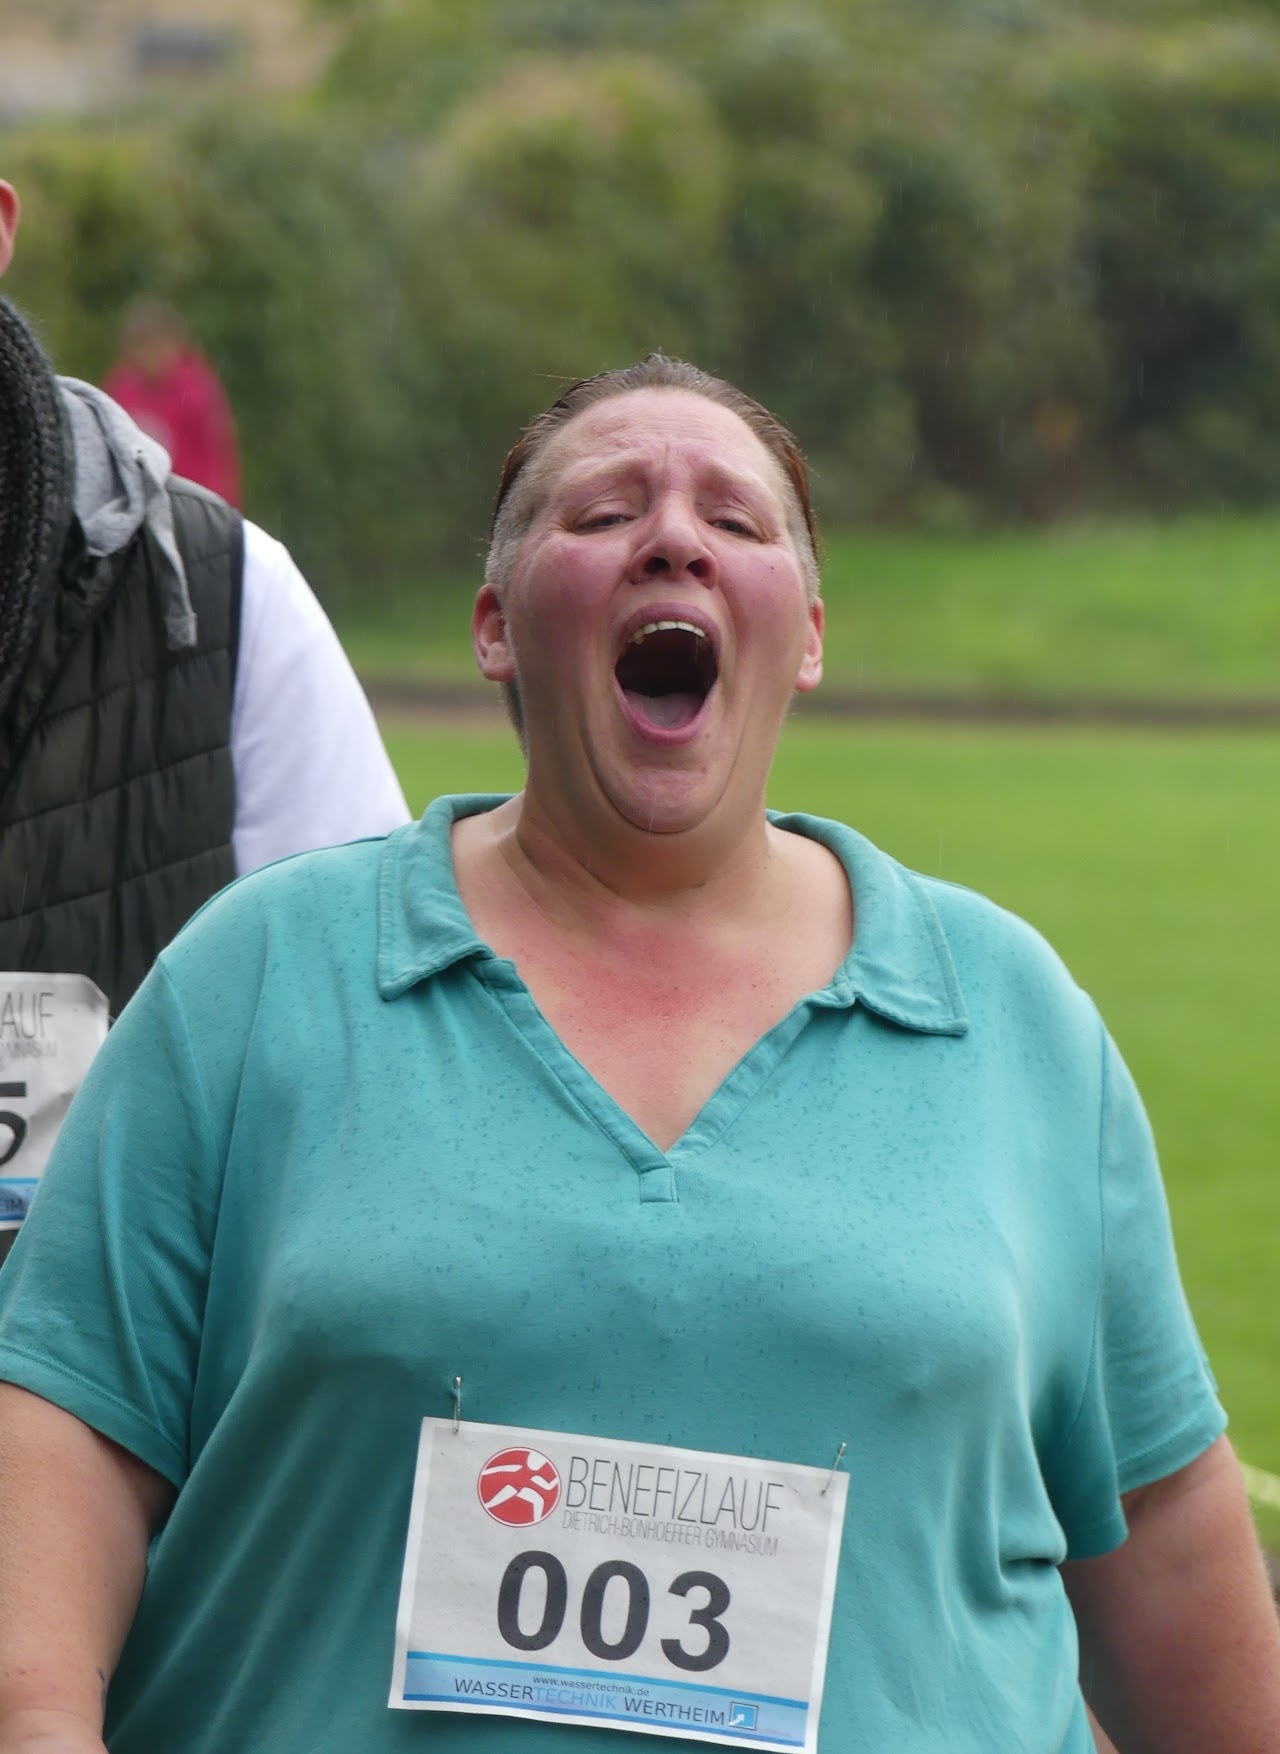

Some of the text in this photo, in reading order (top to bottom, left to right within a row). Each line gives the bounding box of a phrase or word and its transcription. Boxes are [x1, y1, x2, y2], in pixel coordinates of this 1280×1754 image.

[566, 1456, 784, 1533] BENEFIZLAUF
[562, 1510, 779, 1557] DIETRICH-BONHOEFFER GYMNASIUM
[497, 1550, 731, 1672] 003
[454, 1678, 726, 1726] WASSERTECHNIK WERTHEIM
[532, 1675, 650, 1696] www.wassertechnik.de
